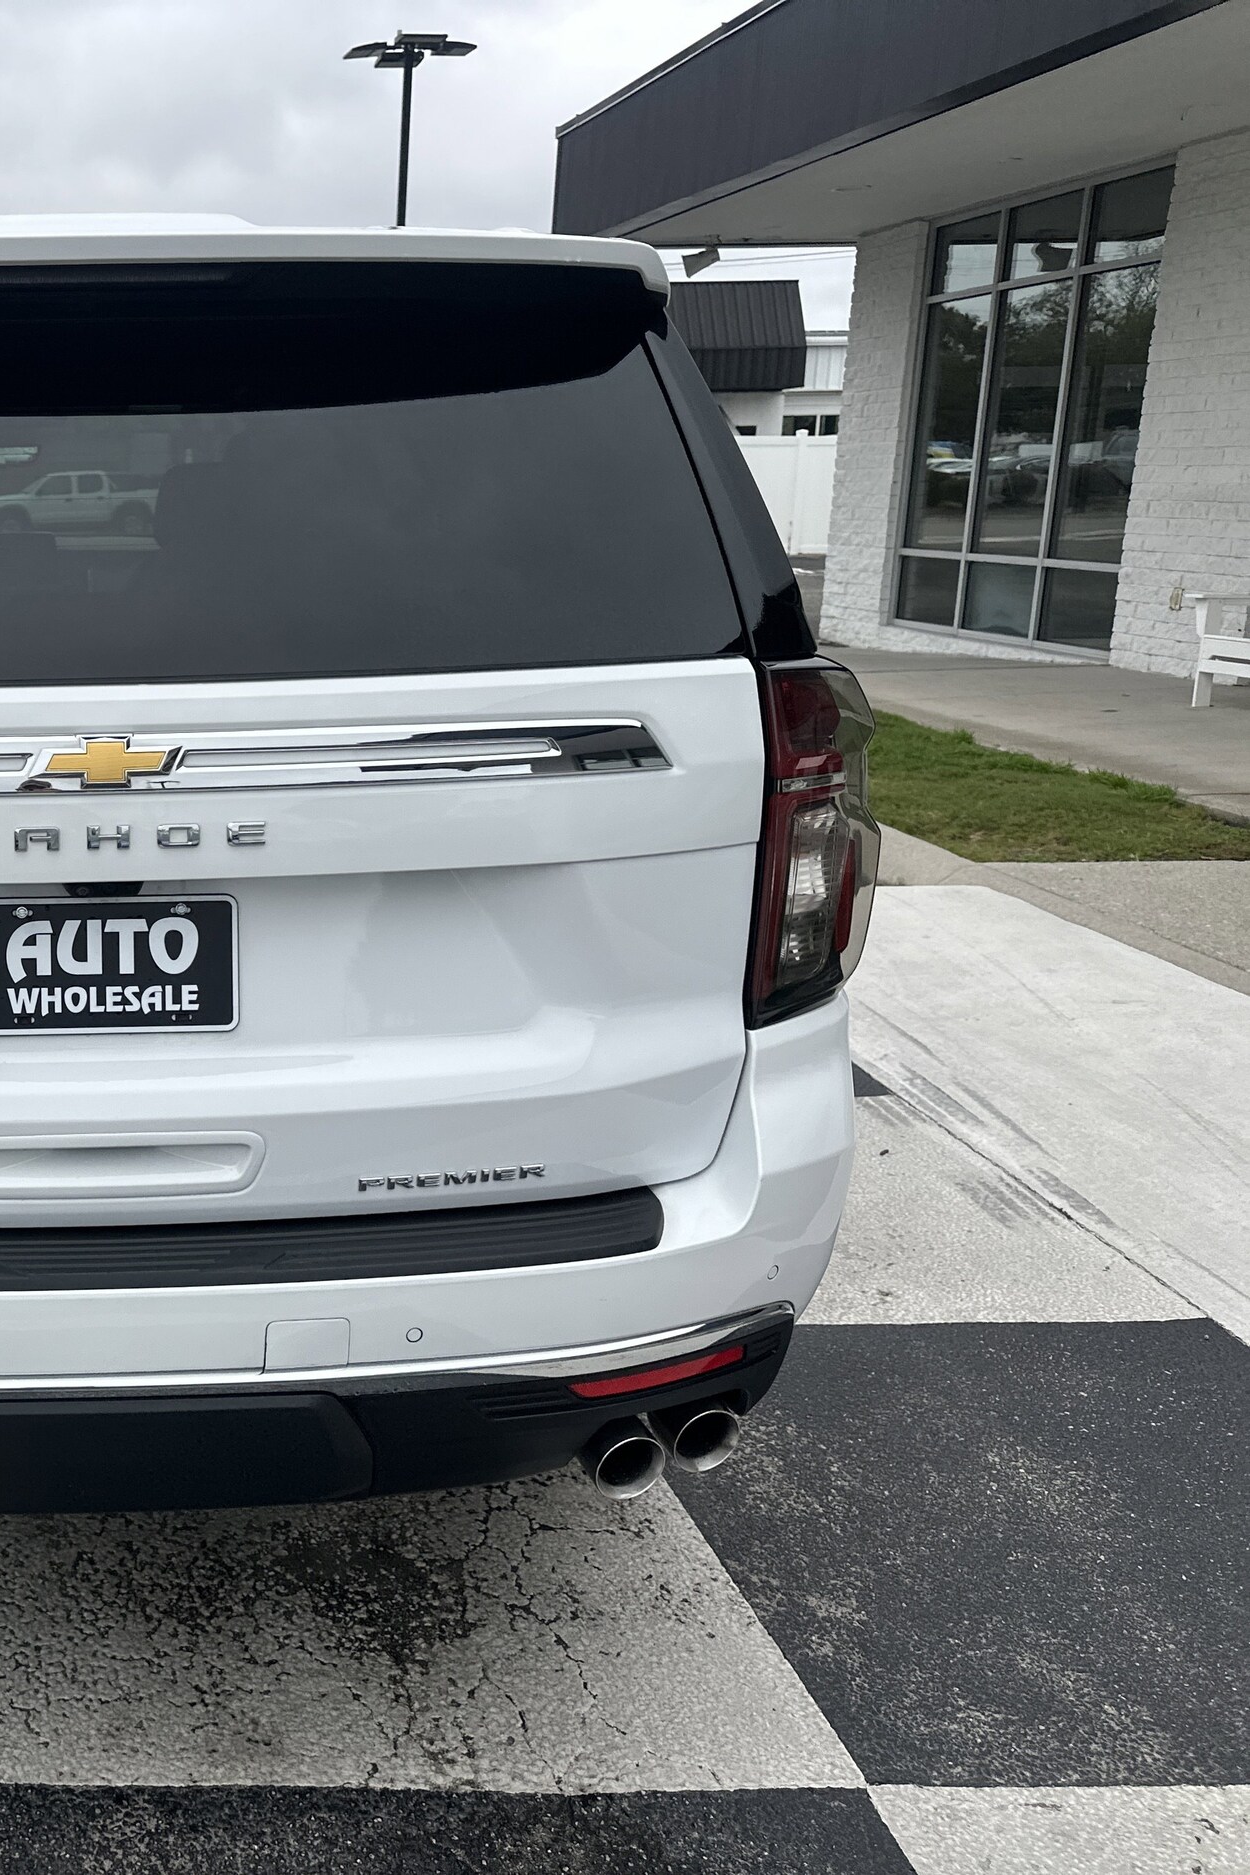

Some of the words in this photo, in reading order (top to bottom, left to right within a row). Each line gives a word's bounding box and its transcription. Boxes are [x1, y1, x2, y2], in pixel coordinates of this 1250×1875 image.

[5, 916, 199, 984] AUTO
[6, 984, 200, 1017] WHOLESALE
[357, 1162, 546, 1192] PREMIER
